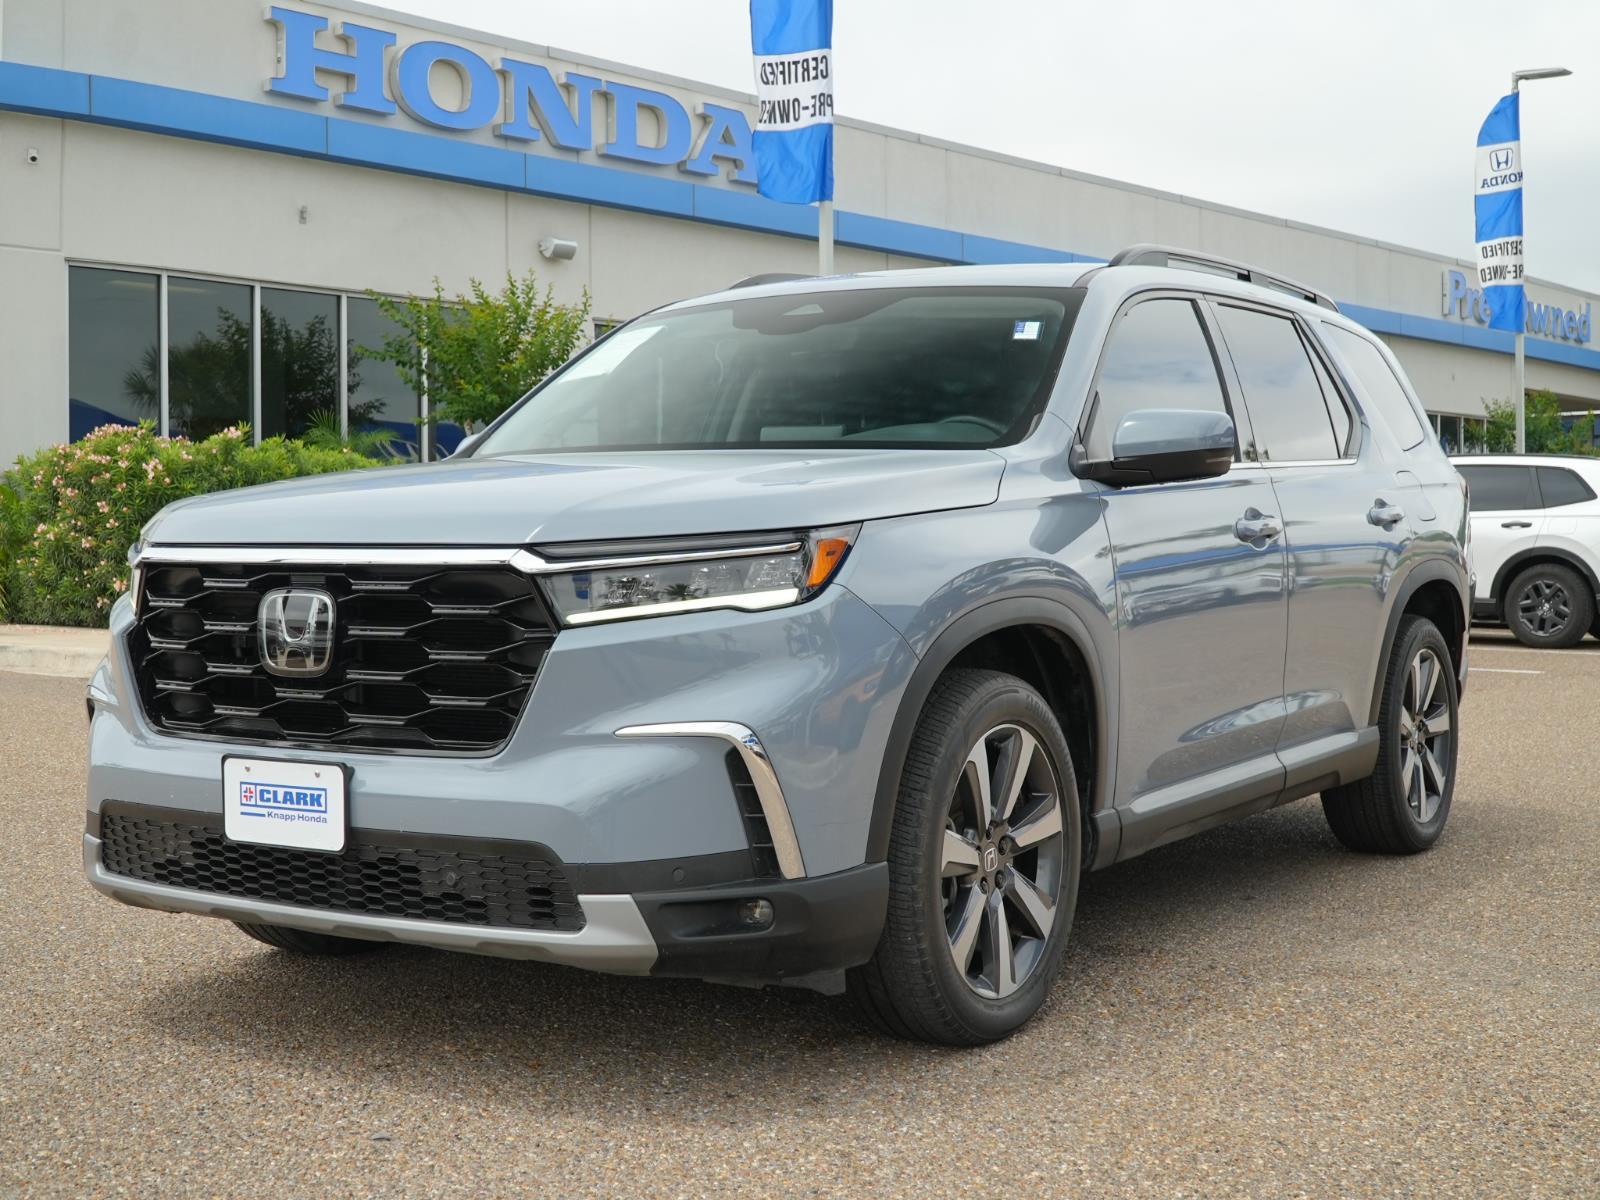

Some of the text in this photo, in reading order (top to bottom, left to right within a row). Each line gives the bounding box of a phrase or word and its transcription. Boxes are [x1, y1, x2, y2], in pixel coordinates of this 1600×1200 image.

[264, 5, 758, 184] HONDA
[259, 789, 323, 807] CLARK
[267, 811, 328, 824] Knapp Honda
